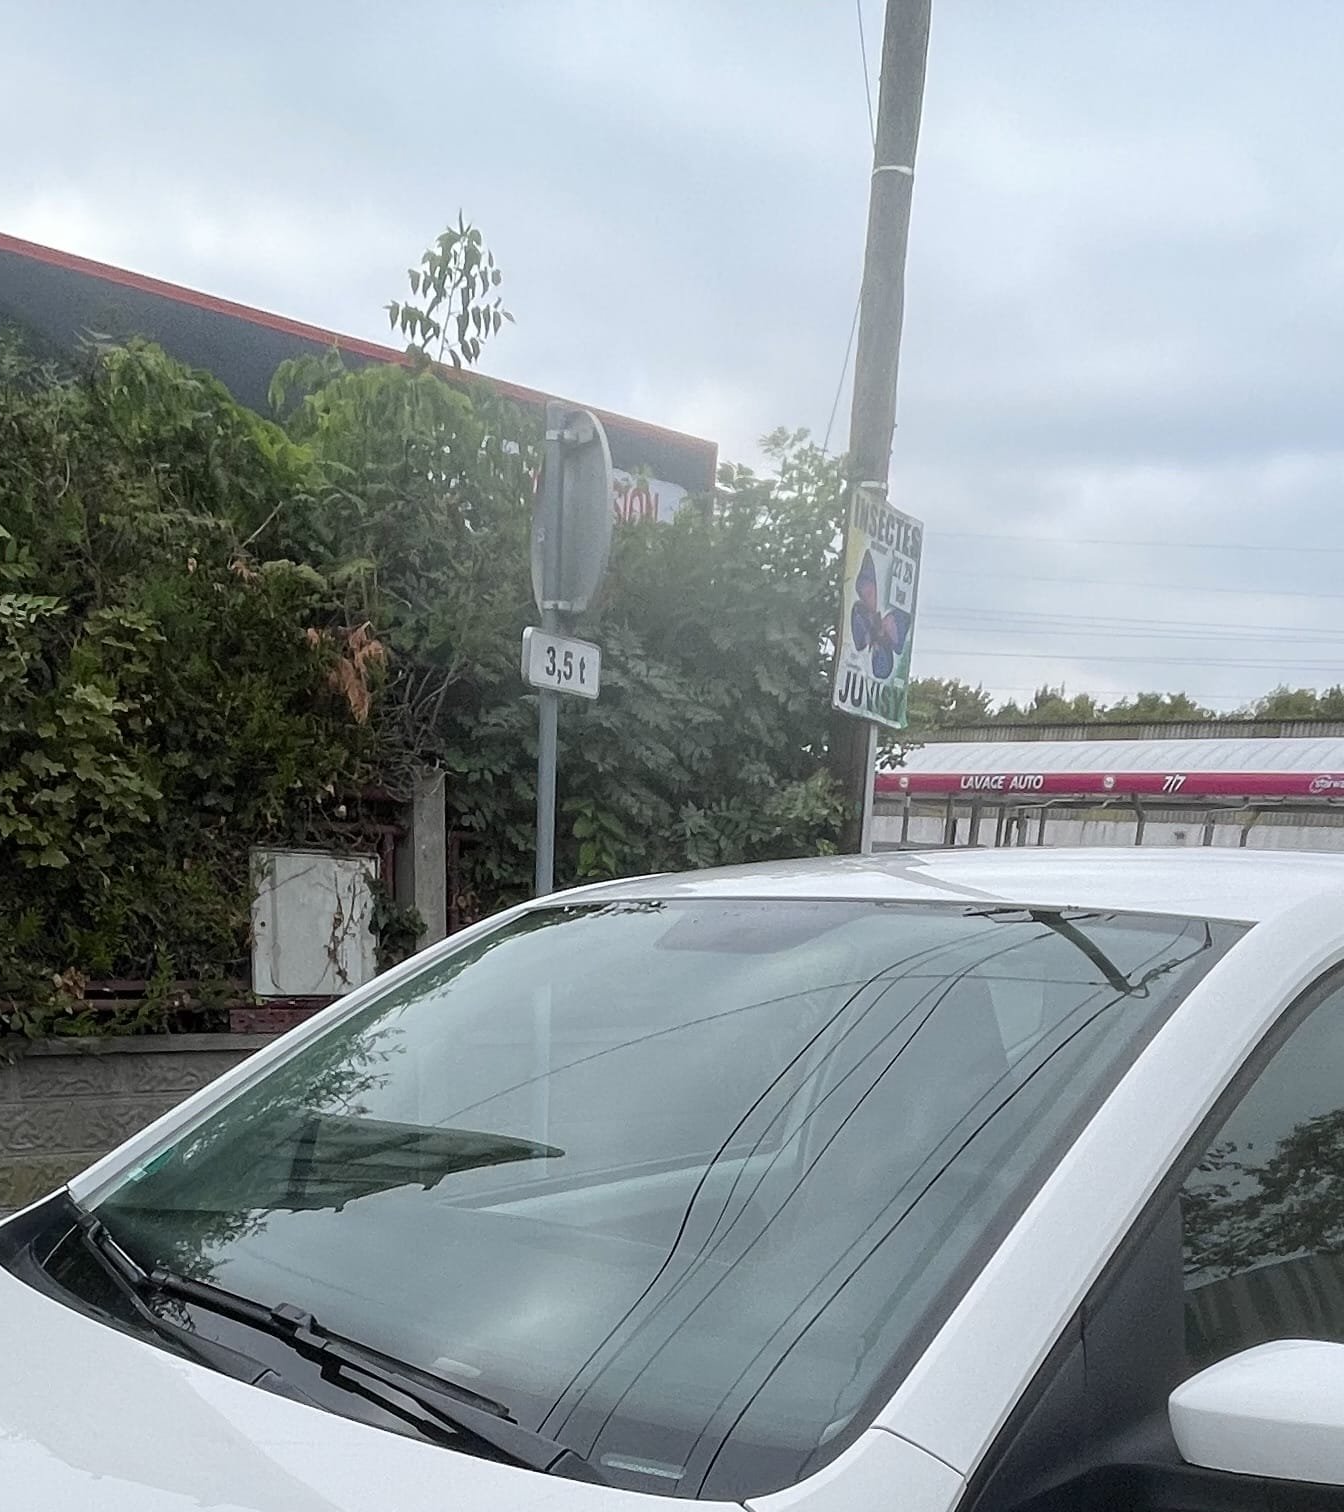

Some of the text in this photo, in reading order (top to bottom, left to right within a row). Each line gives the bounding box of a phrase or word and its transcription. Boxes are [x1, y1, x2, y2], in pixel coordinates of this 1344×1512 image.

[853, 493, 923, 563] INSECTES
[545, 646, 586, 684] 3,5 t
[838, 671, 906, 722] JUVISY
[960, 775, 1044, 790] LAVAGE AUTO
[1162, 774, 1186, 792] 7/7
